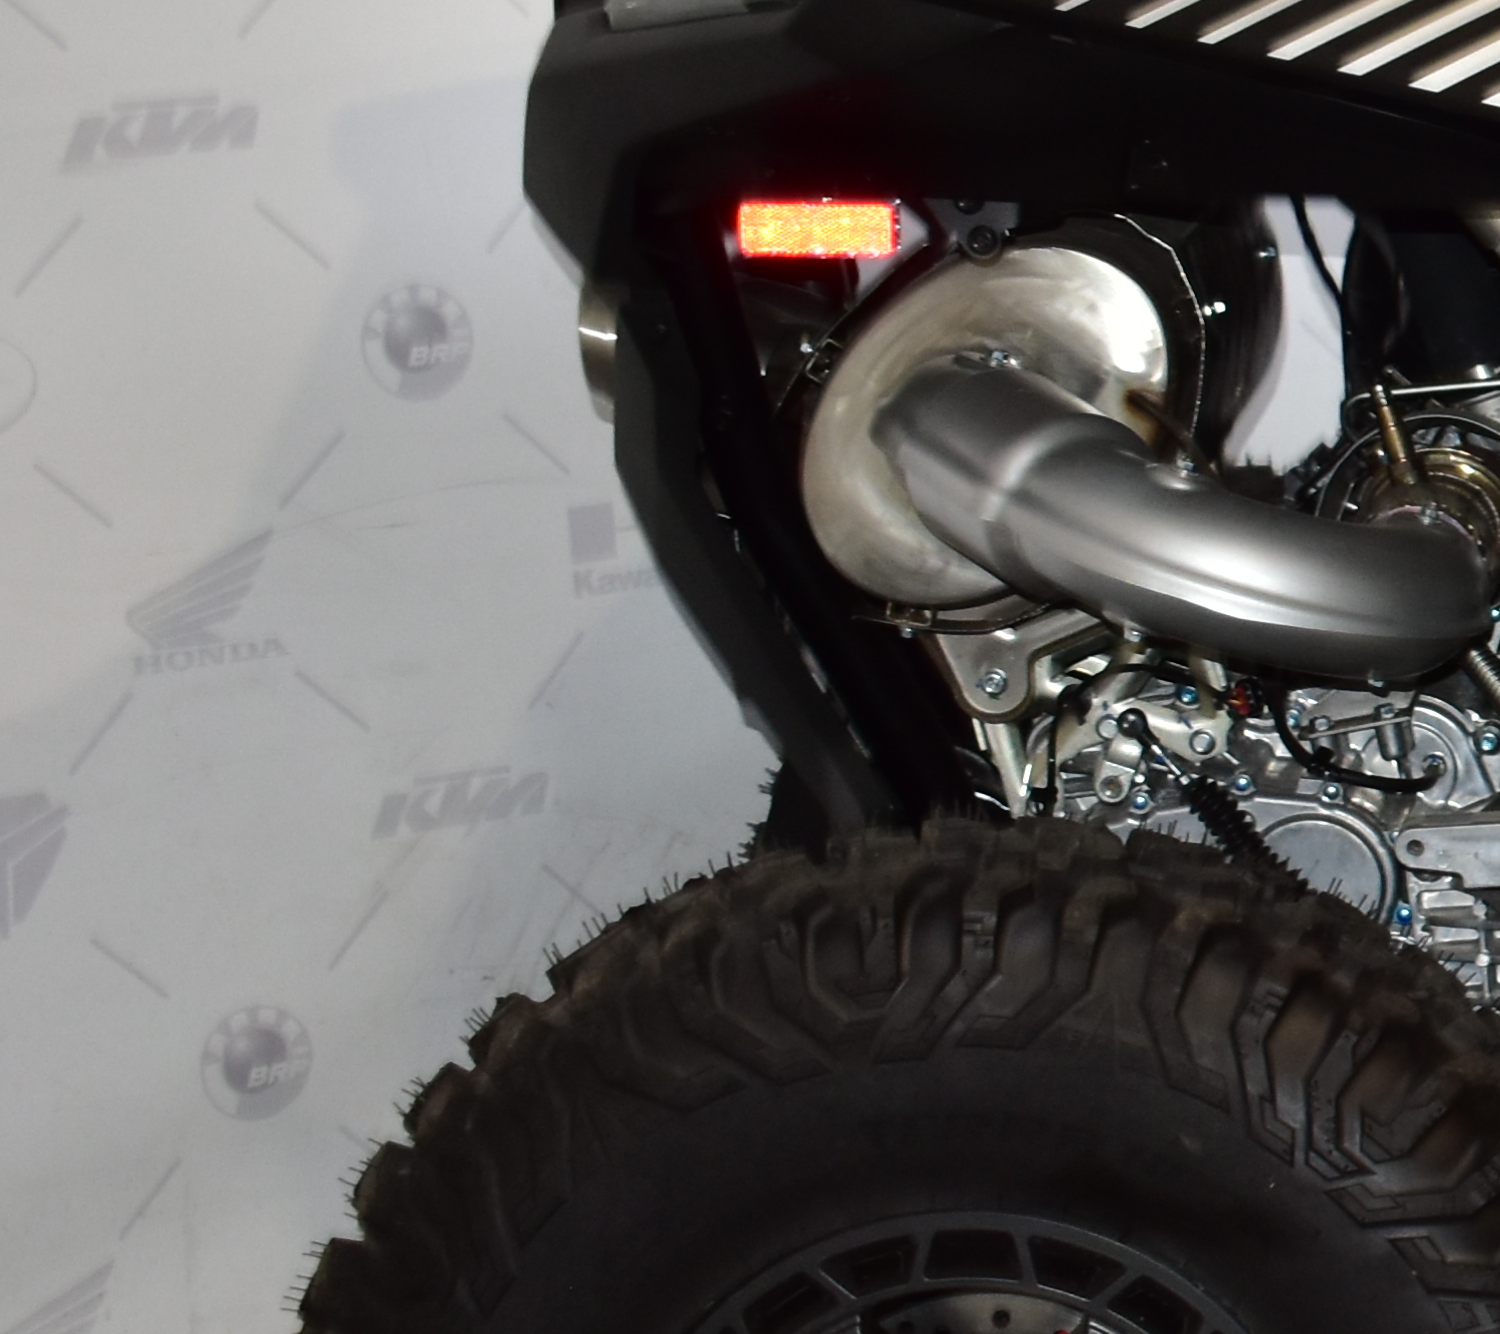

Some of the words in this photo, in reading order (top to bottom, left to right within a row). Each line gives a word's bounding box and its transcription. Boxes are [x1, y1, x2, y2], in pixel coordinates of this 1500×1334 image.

[63, 95, 259, 171] KTM
[572, 569, 668, 600] Kawa
[134, 636, 290, 676] HONDA
[371, 767, 549, 841] KTM
